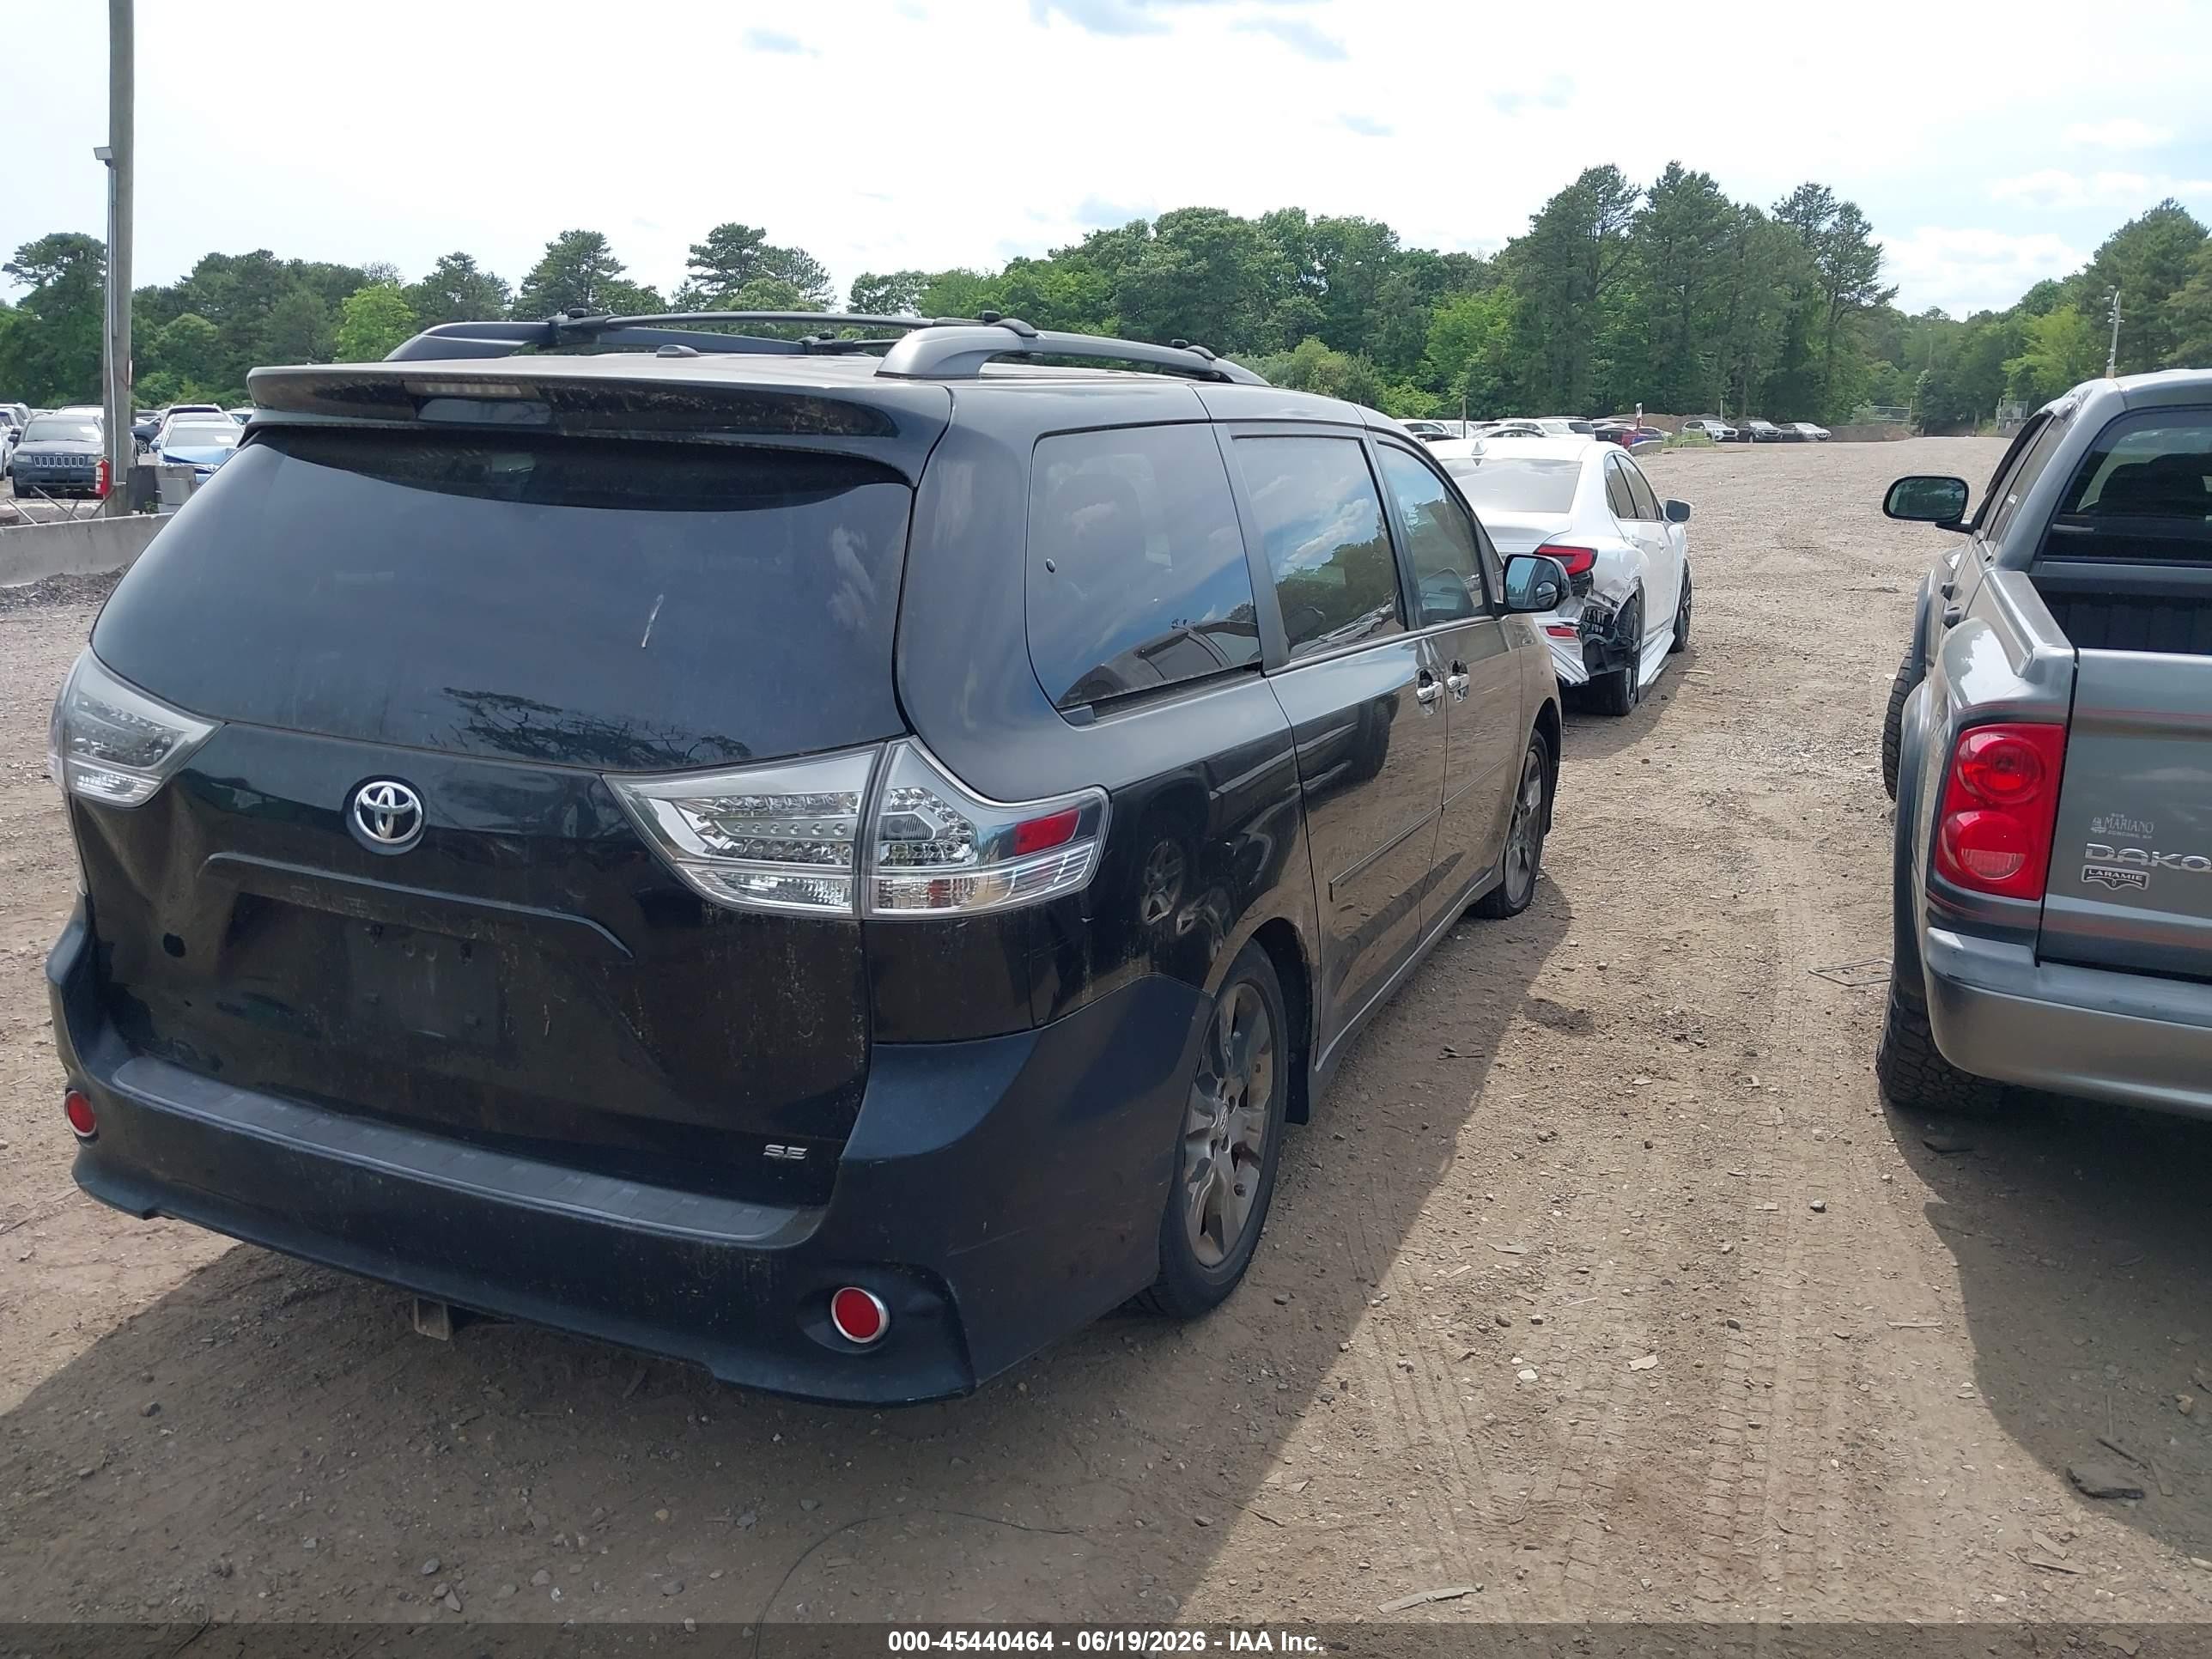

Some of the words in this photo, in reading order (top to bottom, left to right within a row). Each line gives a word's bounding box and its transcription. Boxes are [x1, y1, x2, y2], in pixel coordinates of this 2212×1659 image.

[2105, 817, 2154, 833] MARIANO
[2088, 869, 2144, 881] LARAMIE
[763, 1144, 807, 1160] SE
